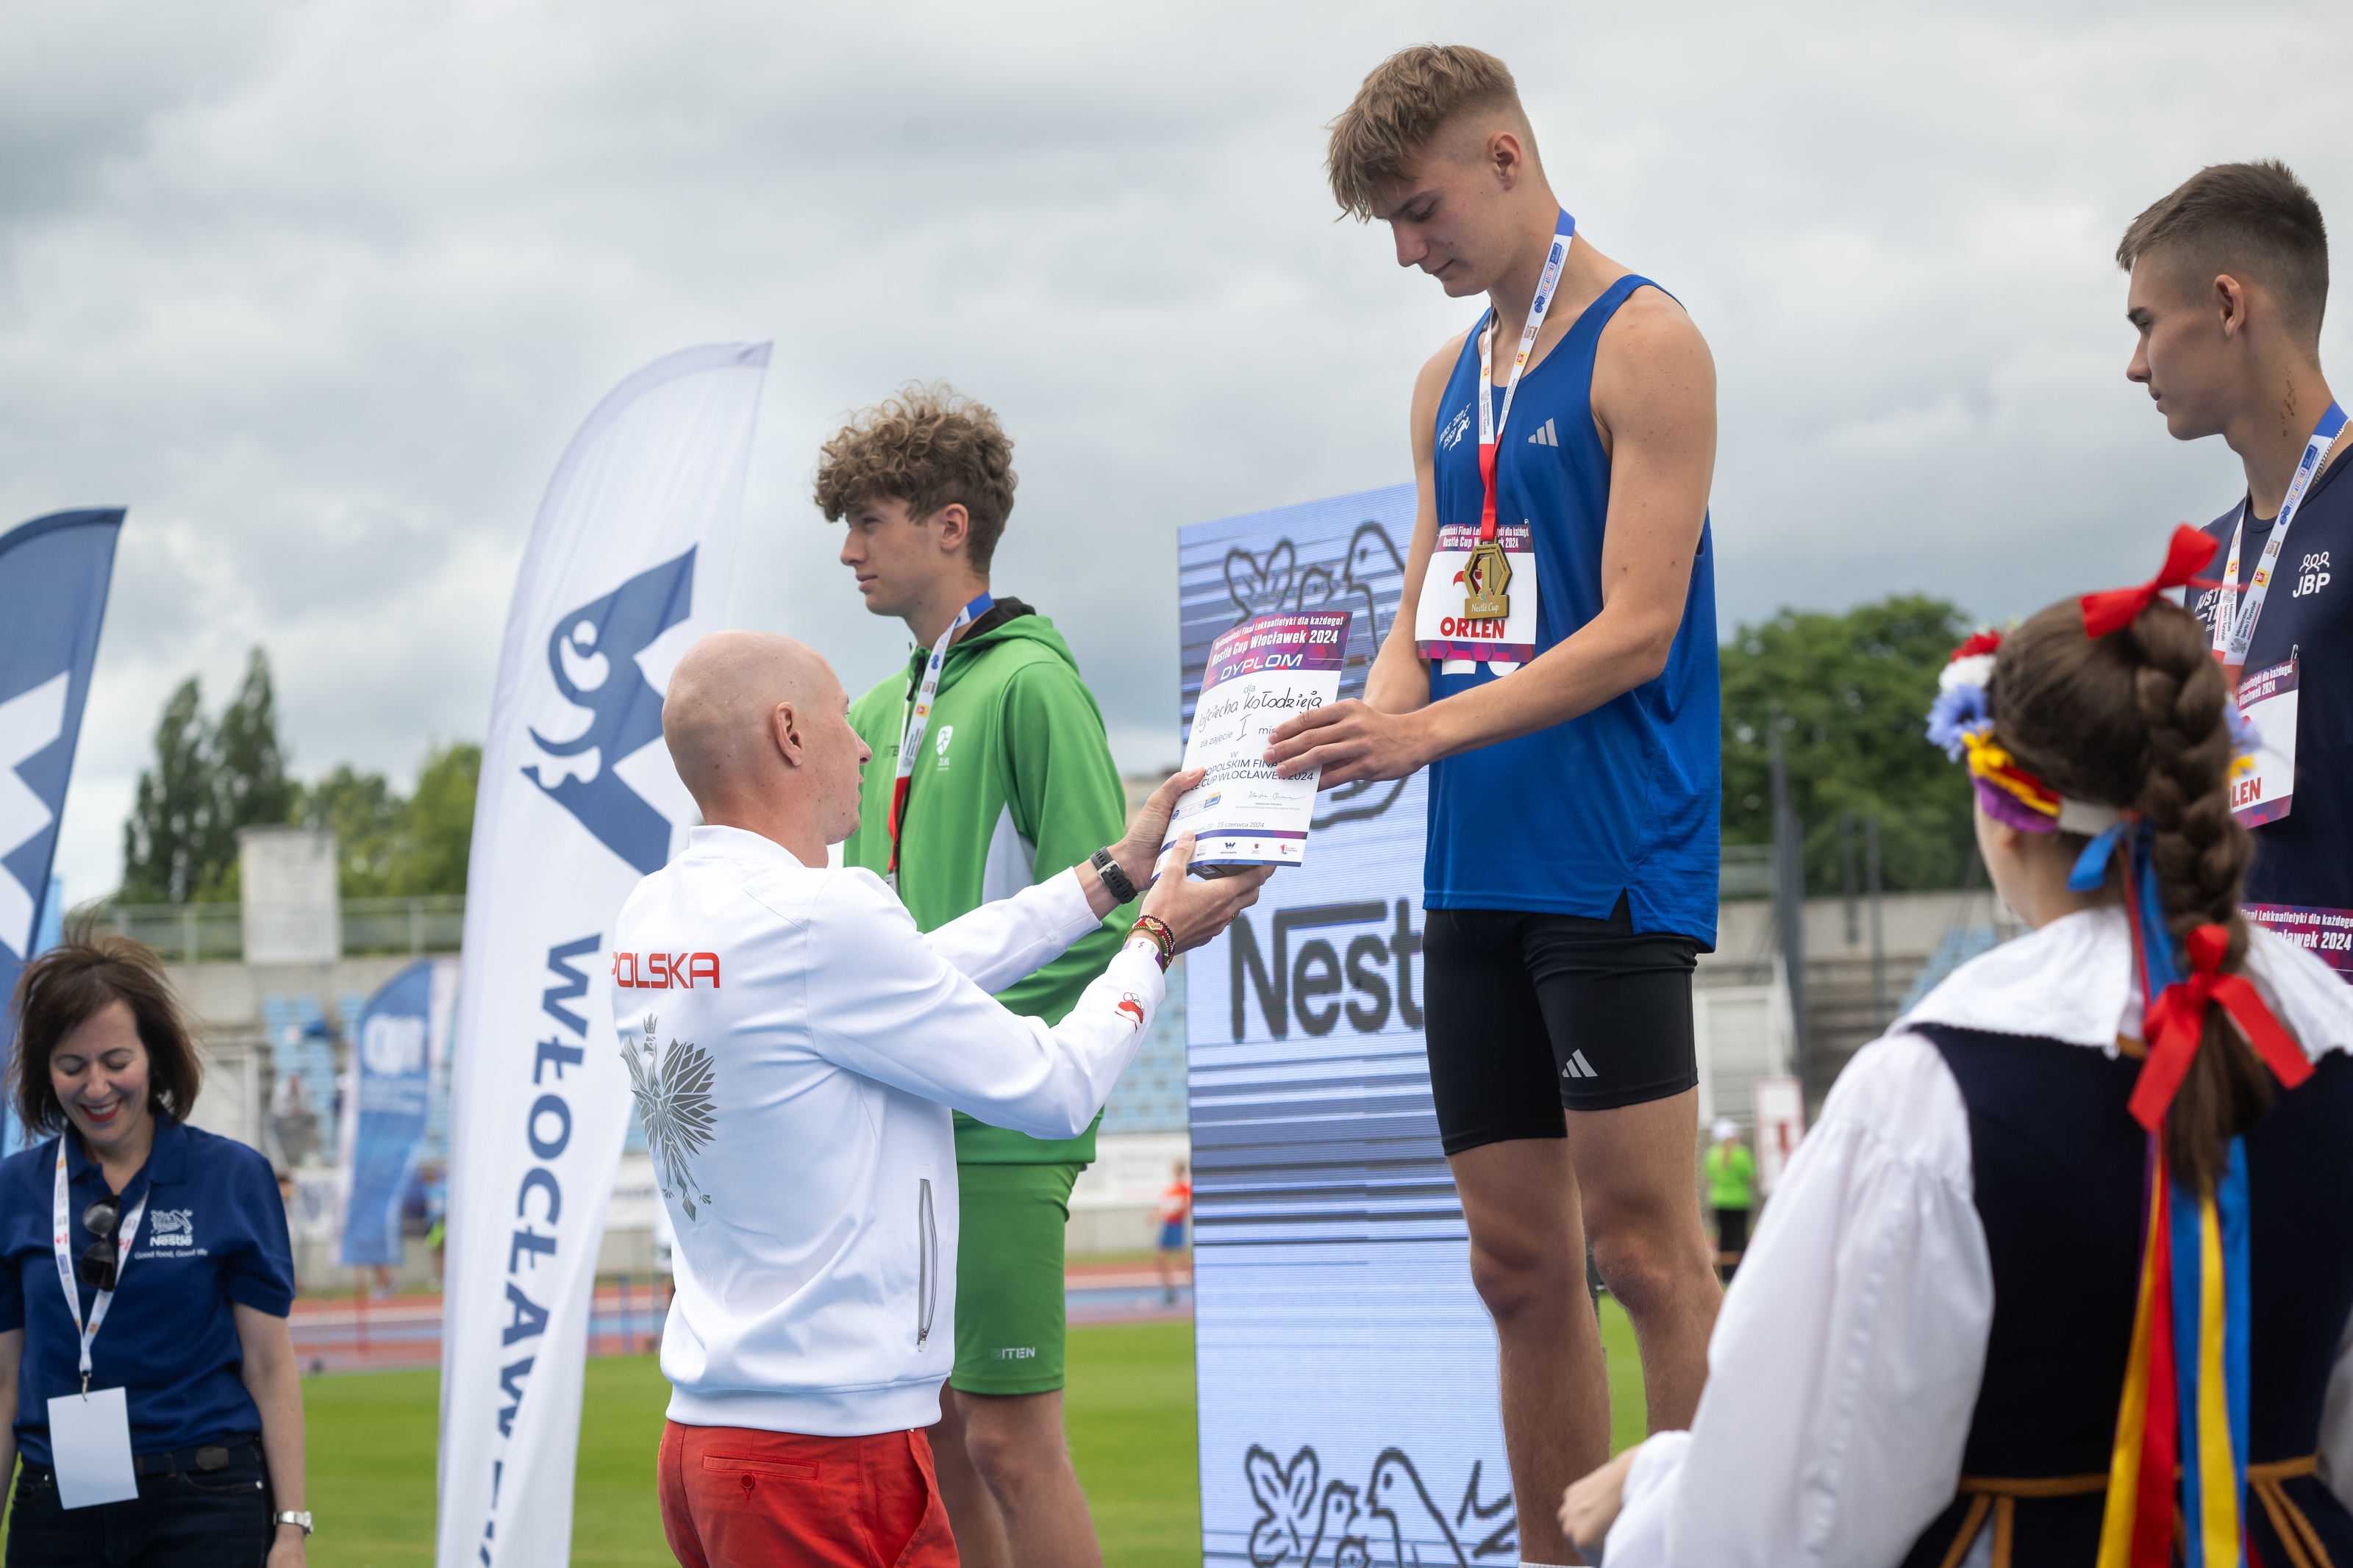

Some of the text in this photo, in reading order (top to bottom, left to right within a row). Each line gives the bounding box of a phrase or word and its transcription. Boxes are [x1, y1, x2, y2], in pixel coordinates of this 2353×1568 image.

[1541, 263, 1555, 297] LEKKOATLETYKA
[2288, 469, 2307, 506] LEKKOATLETYKA
[1460, 537, 1473, 548] Cup
[1505, 537, 1519, 548] 2024
[1504, 527, 1513, 536] dla
[1477, 556, 1491, 591] 1
[2292, 573, 2331, 598] JBP
[1471, 601, 1499, 614] Nestlé Cup
[2194, 586, 2221, 613] JUST
[1241, 623, 1254, 636] Finał
[1254, 617, 1296, 631] Lekkoatletyki
[1297, 616, 1309, 626] dla
[1310, 616, 1344, 627] każdego!
[1440, 617, 1506, 639] ORLEN
[2235, 608, 2249, 637] Ministerstwo
[2240, 623, 2249, 639] Sportu
[2246, 601, 2257, 620] Turystyki
[1210, 630, 1339, 667] Nestlé Cup Włocławek 2024
[1220, 654, 1304, 681] DYPLOM
[2262, 671, 2270, 682] dla
[2270, 663, 2293, 679] każdego!
[1243, 684, 1256, 694] dla
[2262, 679, 2275, 695] 2024
[1236, 713, 1252, 742] I
[1199, 731, 1233, 748] za zajęcie
[1202, 770, 1314, 787] CUP WŁOCŁAWE 2024
[1203, 759, 1283, 777] OPOLSKIM FINA
[2232, 776, 2261, 808] LEN
[2259, 910, 2307, 926] Lekkoatletyki
[2308, 913, 2320, 925] dla
[2321, 931, 2352, 951] 2024
[611, 951, 720, 989] POLSKA
[1229, 898, 1424, 1045] Nest
[135, 1250, 155, 1260] Good
[176, 1248, 196, 1258] Good
[480, 933, 601, 1568] WŁOCŁAW
